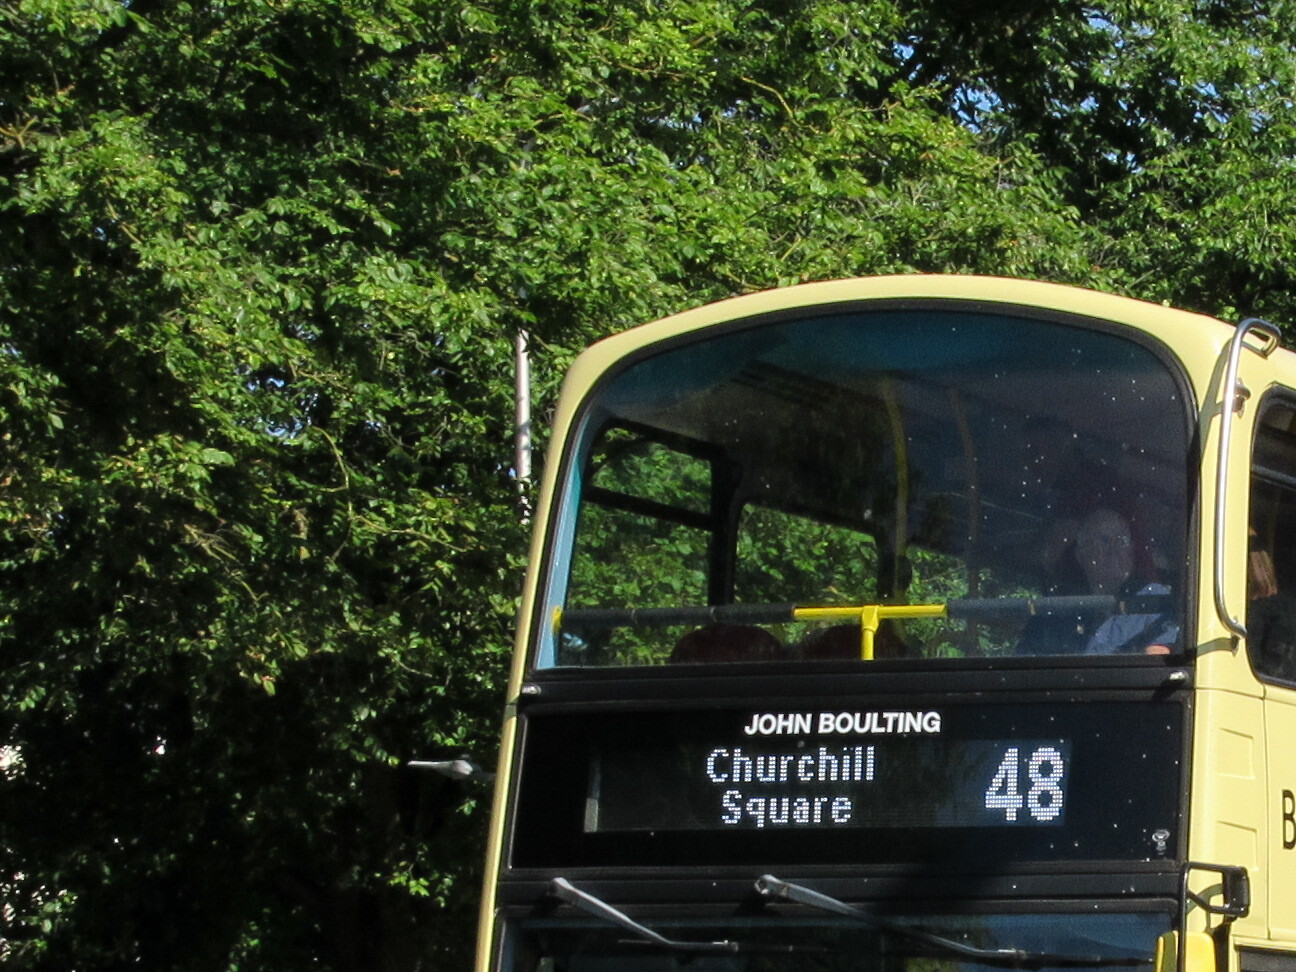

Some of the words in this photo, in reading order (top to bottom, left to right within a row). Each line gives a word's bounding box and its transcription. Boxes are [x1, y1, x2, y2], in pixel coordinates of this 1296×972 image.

[744, 712, 813, 736] JOHN
[818, 711, 942, 735] BOULTING
[706, 745, 877, 783] Churchill
[984, 747, 1064, 823] 48
[721, 790, 853, 828] Square
